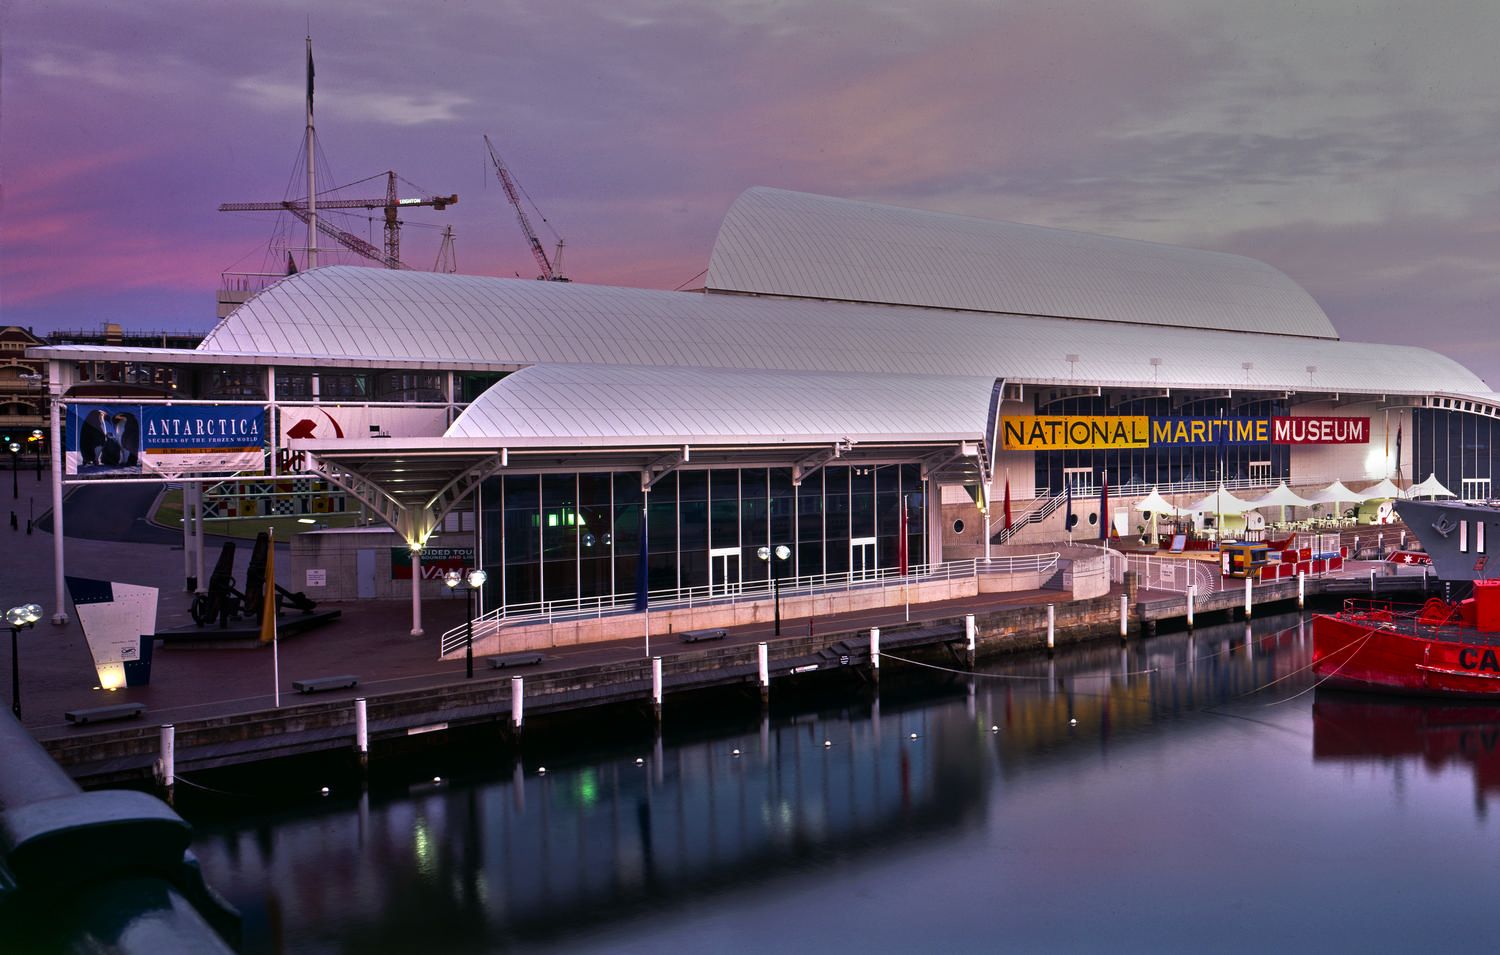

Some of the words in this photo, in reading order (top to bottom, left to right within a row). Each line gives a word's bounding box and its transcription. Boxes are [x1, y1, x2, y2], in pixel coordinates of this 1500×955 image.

[148, 420, 258, 435] ANTARCTICA
[1004, 420, 1147, 445] NATIONAL
[1152, 419, 1269, 443] MARITIME
[1274, 419, 1364, 441] MUSEUM
[1460, 520, 1484, 552] 11
